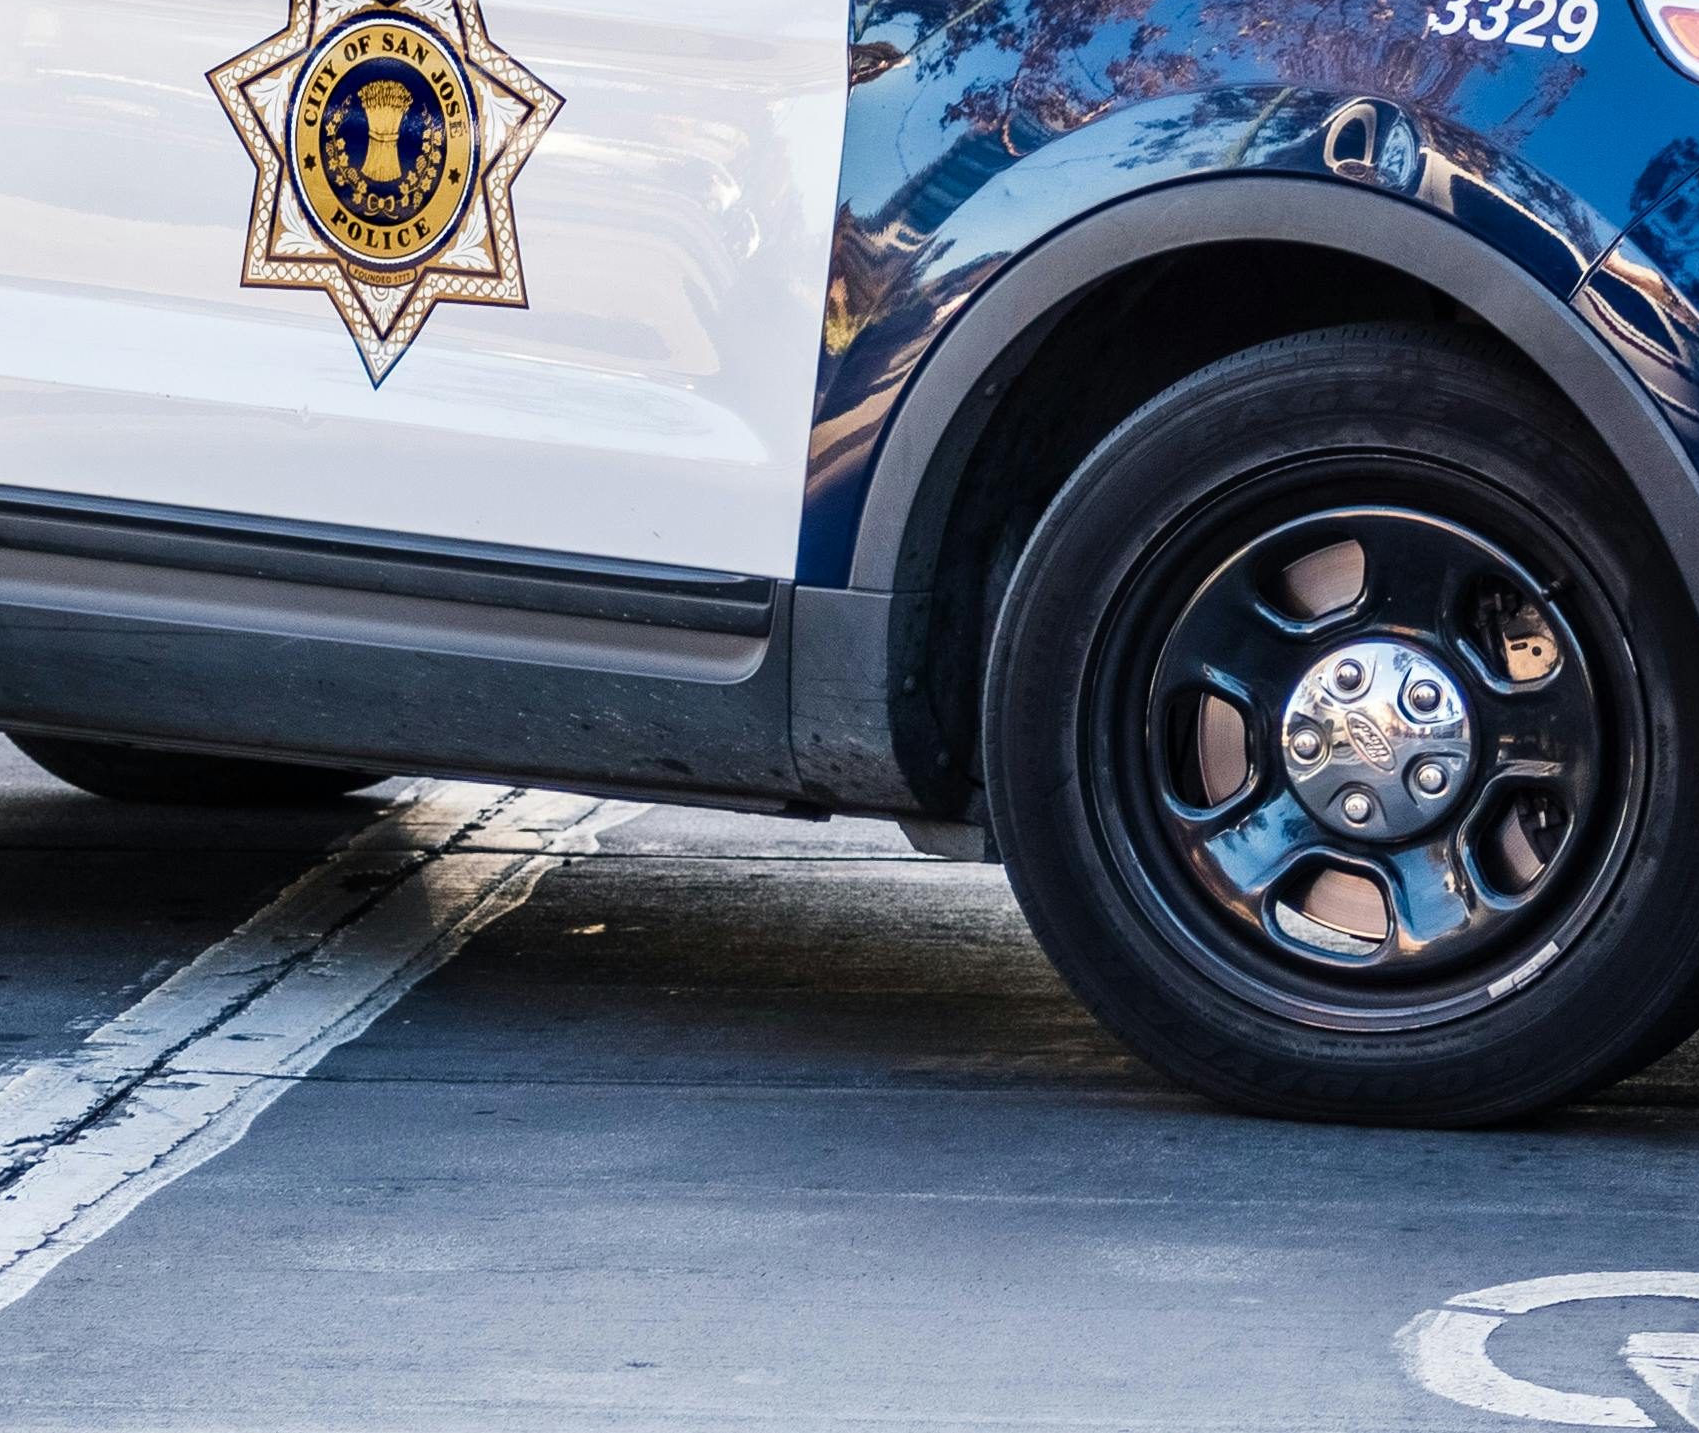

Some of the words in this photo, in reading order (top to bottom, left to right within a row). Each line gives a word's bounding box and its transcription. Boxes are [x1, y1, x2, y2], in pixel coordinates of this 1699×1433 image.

[303, 60, 338, 127] CITY
[343, 35, 371, 62] OF
[382, 32, 430, 66] SAN
[330, 207, 431, 250] POLICE
[354, 268, 392, 284] FOUNDED
